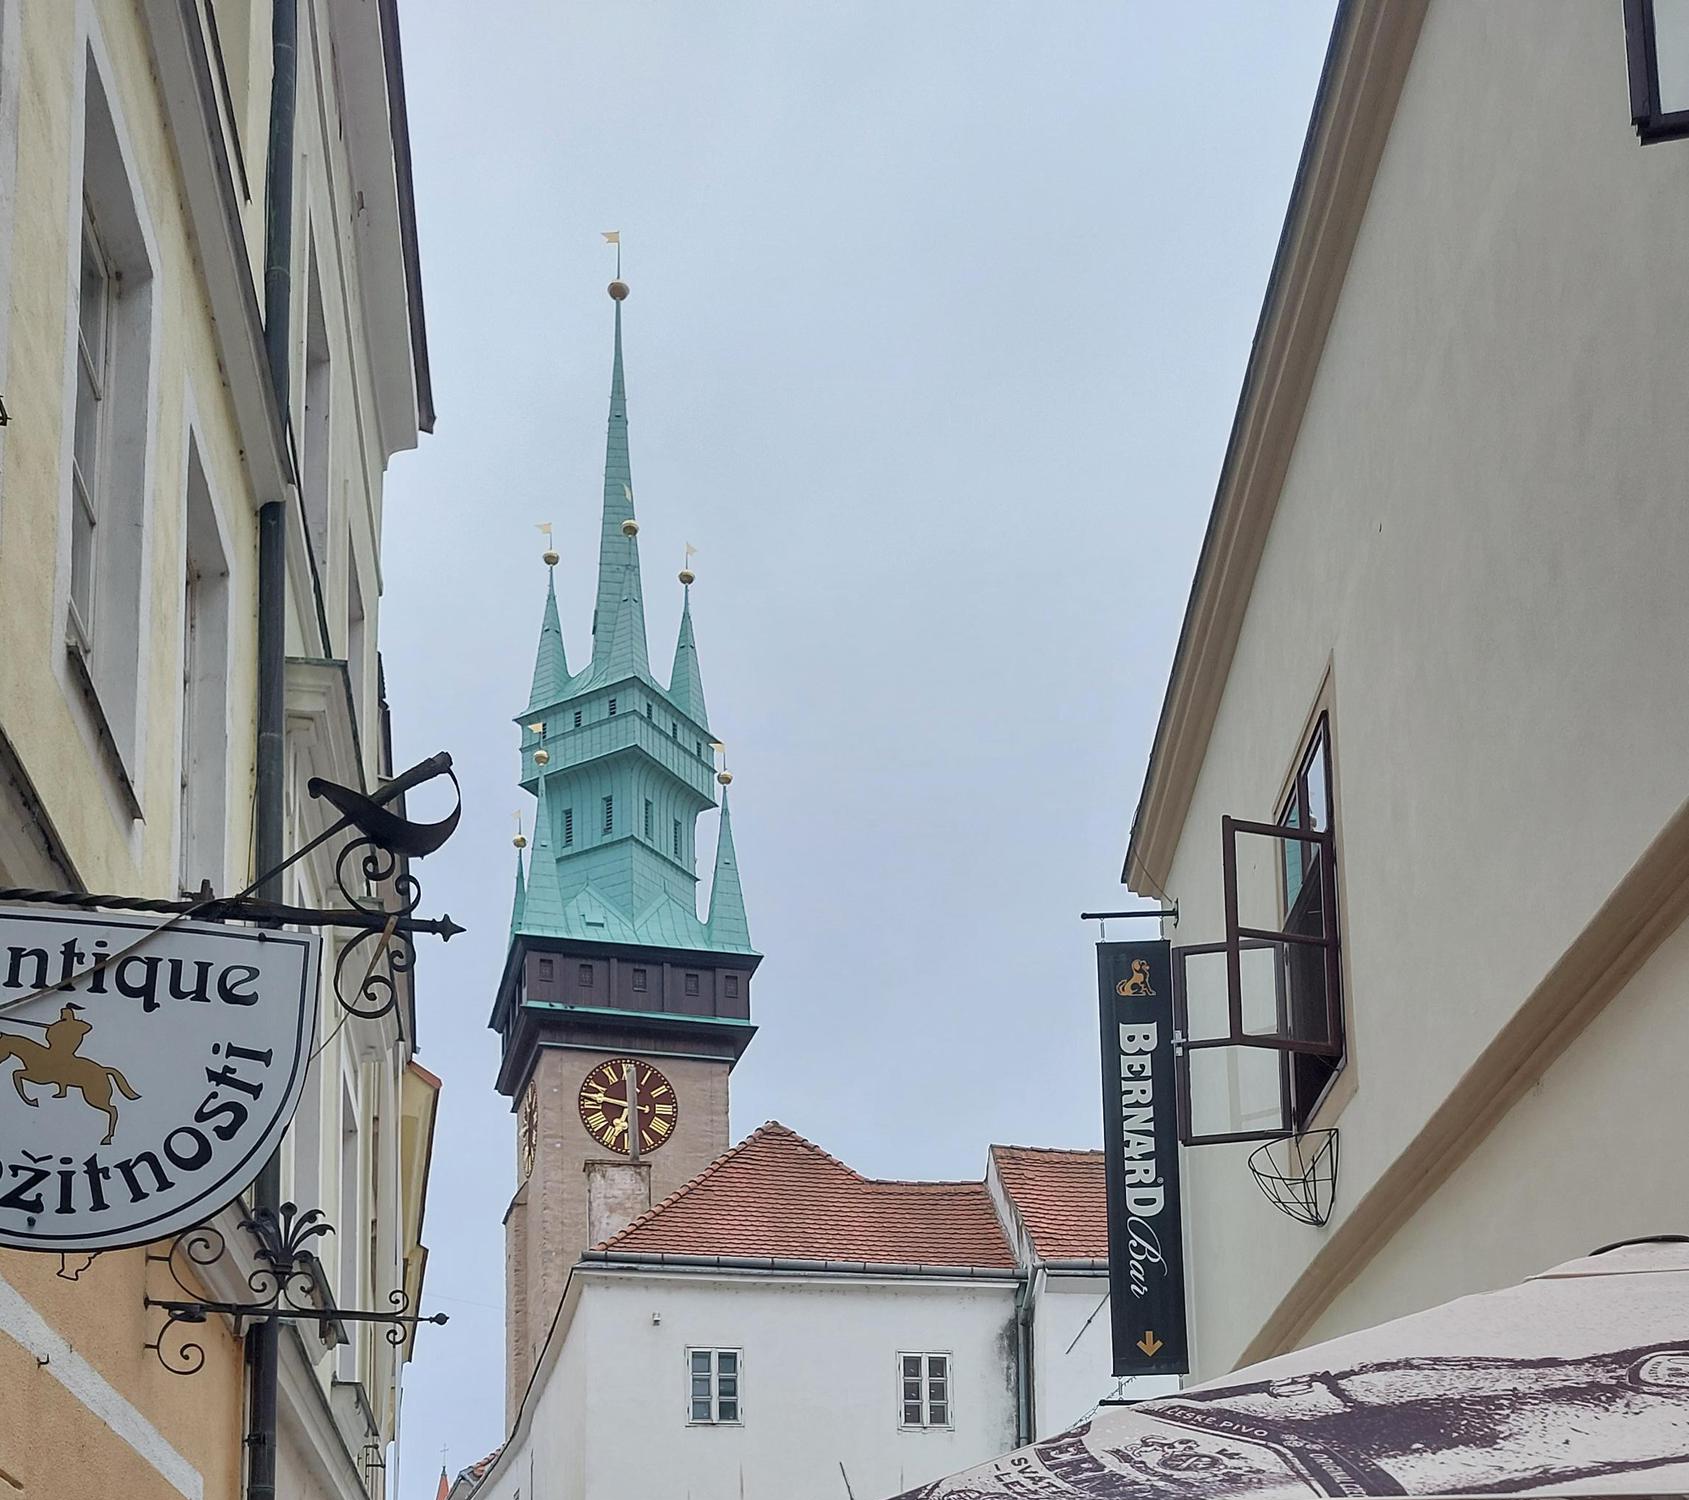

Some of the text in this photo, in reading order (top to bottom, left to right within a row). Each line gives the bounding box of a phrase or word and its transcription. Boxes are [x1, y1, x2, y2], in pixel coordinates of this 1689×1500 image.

[2, 937, 261, 1013] ntique
[0, 1042, 273, 1214] žitnosti
[1118, 1021, 1168, 1299] BERNARD Bar
[1219, 1419, 1269, 1438] PIVO
